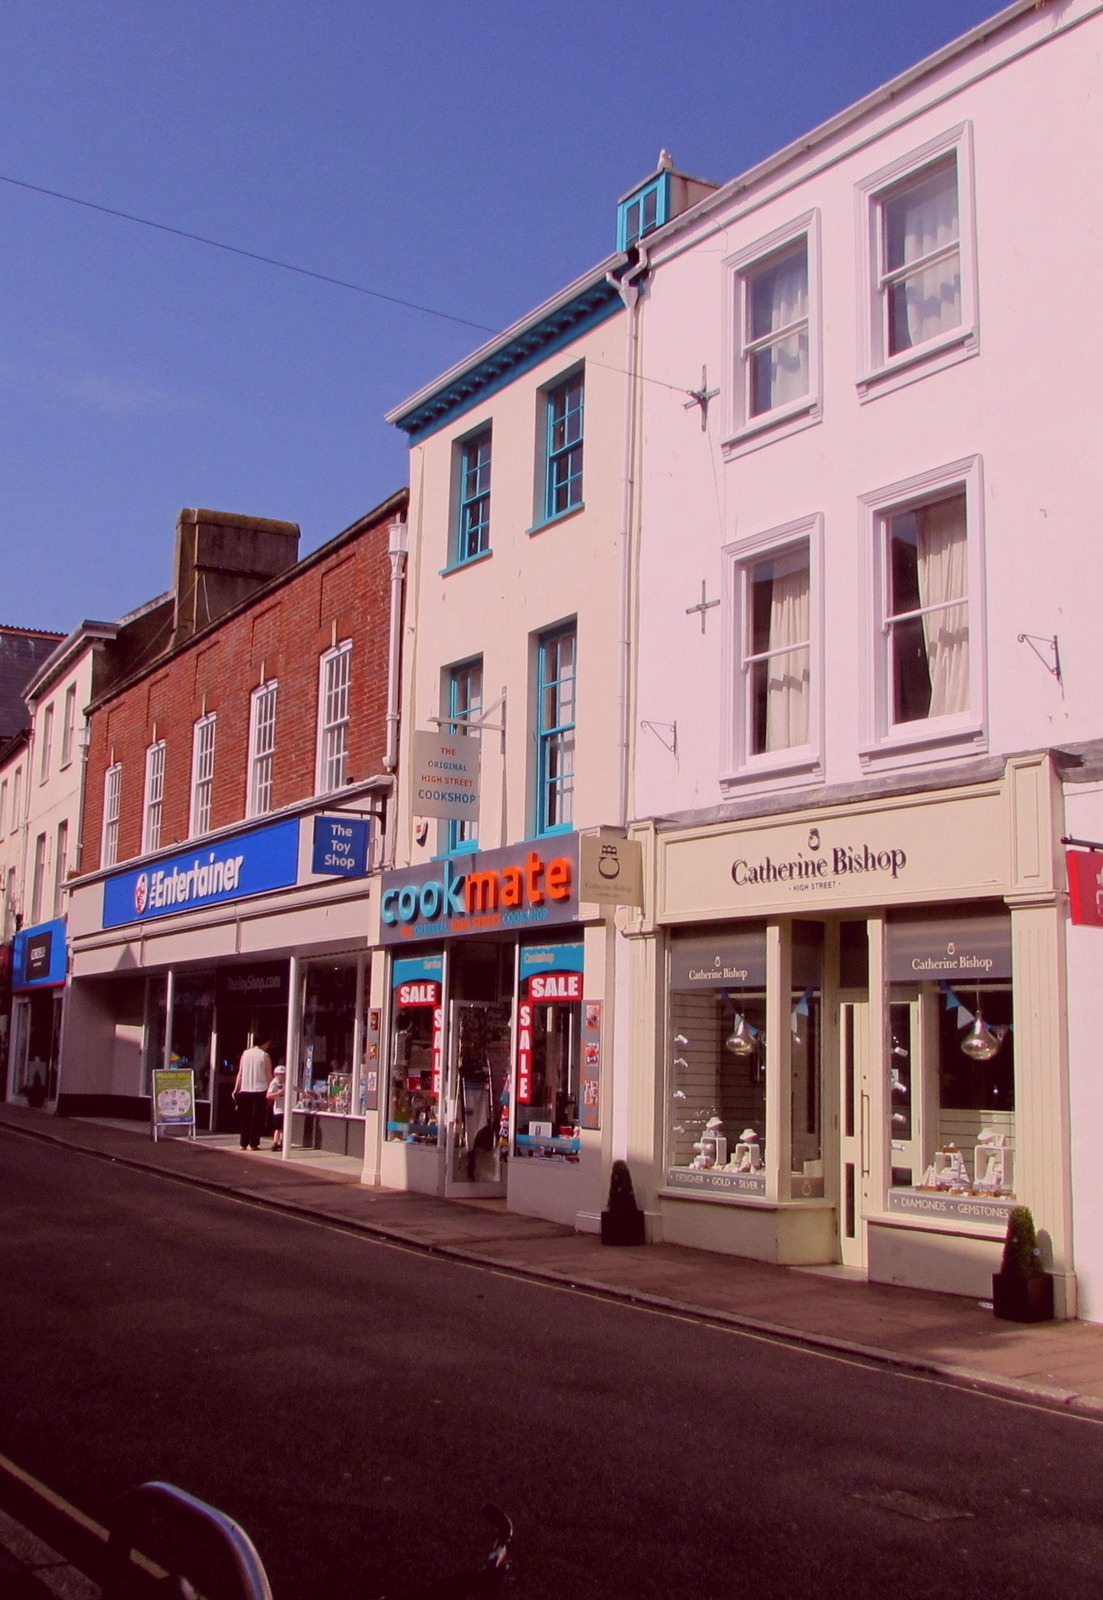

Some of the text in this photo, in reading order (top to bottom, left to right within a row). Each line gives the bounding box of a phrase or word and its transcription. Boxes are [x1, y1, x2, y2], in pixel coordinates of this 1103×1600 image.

[441, 747, 456, 756] THE
[428, 760, 468, 771] ORIGINAL
[421, 774, 473, 787] HIGH STREET
[418, 789, 476, 804] COOKSHOP
[331, 824, 353, 837] The
[331, 839, 352, 855] Toy
[324, 853, 356, 870] Shop
[731, 844, 907, 886] Catherine Bishop
[155, 852, 244, 908] Entertainer
[793, 881, 837, 892] HIGH STREET
[381, 852, 574, 925] cookmate
[414, 922, 449, 936] ORIGINAL
[502, 908, 549, 925] COOKSHOP
[911, 955, 993, 971] Catherine Bishop
[688, 967, 748, 981] Catherine Bishop
[400, 985, 435, 1004] SALE
[531, 976, 579, 998] SALE
[519, 1005, 531, 1099] SALE
[711, 1177, 731, 1187] GOLD
[738, 1179, 759, 1190] SILVER
[901, 1197, 1010, 1219] DIAMONDS GEMSTONES
